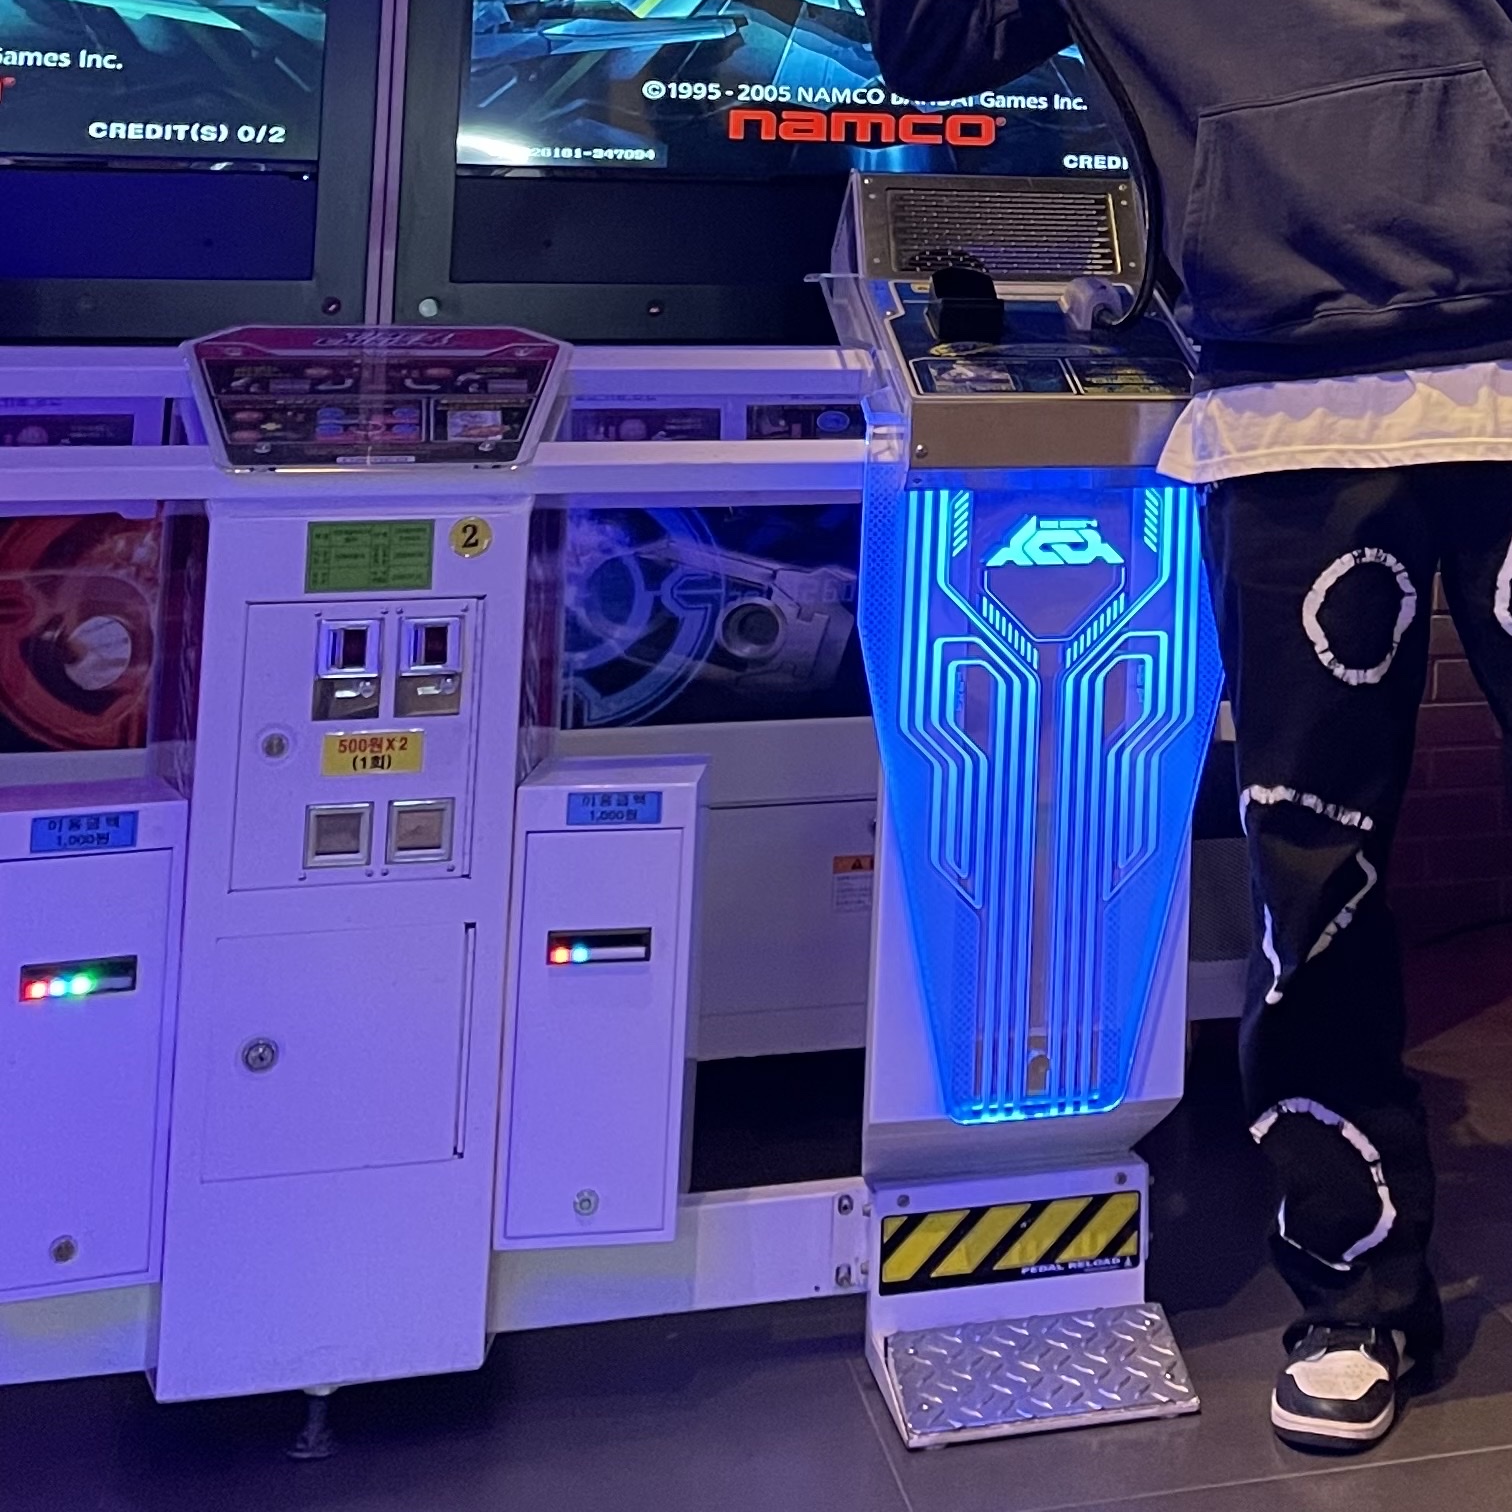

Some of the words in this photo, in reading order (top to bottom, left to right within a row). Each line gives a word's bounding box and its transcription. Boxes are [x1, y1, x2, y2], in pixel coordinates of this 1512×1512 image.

[79, 49, 123, 70] Inc.
[737, 84, 791, 102] 2005
[797, 86, 885, 104] NAMCO
[980, 90, 1048, 109] Games
[1053, 93, 1088, 111] Inc.
[88, 121, 229, 142] CREDIT(S)
[237, 124, 287, 144] 0/2
[729, 108, 997, 147] namco
[1063, 154, 1129, 171] CREDI
[461, 524, 480, 549] 2
[1021, 1263, 1065, 1275] PEDAL
[1067, 1256, 1121, 1270] RELOAD
